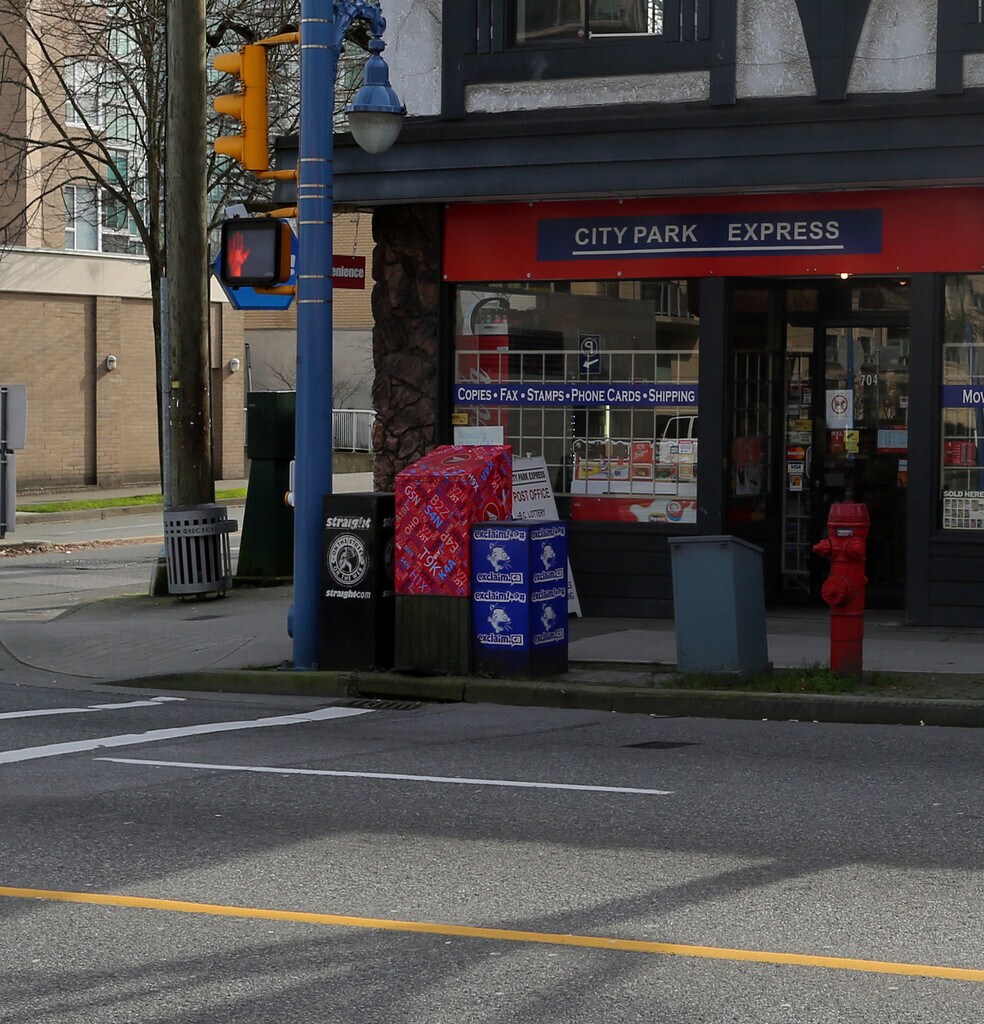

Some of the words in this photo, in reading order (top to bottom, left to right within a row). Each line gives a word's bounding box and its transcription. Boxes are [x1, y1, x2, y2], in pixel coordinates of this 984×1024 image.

[575, 226, 627, 246] CITY
[633, 224, 698, 244] PARK
[727, 221, 841, 242] EXPRESS
[333, 266, 364, 278] enience
[861, 374, 878, 386] 704
[458, 388, 492, 400] COPIES
[500, 388, 518, 400] FAX
[527, 388, 564, 401] STAMPS
[571, 388, 605, 401] PHONE
[607, 388, 641, 402] CARDS
[648, 388, 695, 402] SHIPPING
[518, 473, 528, 481] PARK
[529, 471, 545, 479] EXPRESS
[513, 490, 529, 502] POST
[530, 488, 550, 500] OFFICE
[424, 504, 443, 528] S4N
[528, 509, 545, 518] LOTTERY
[420, 546, 441, 577] T9K
[438, 560, 456, 580] K4A
